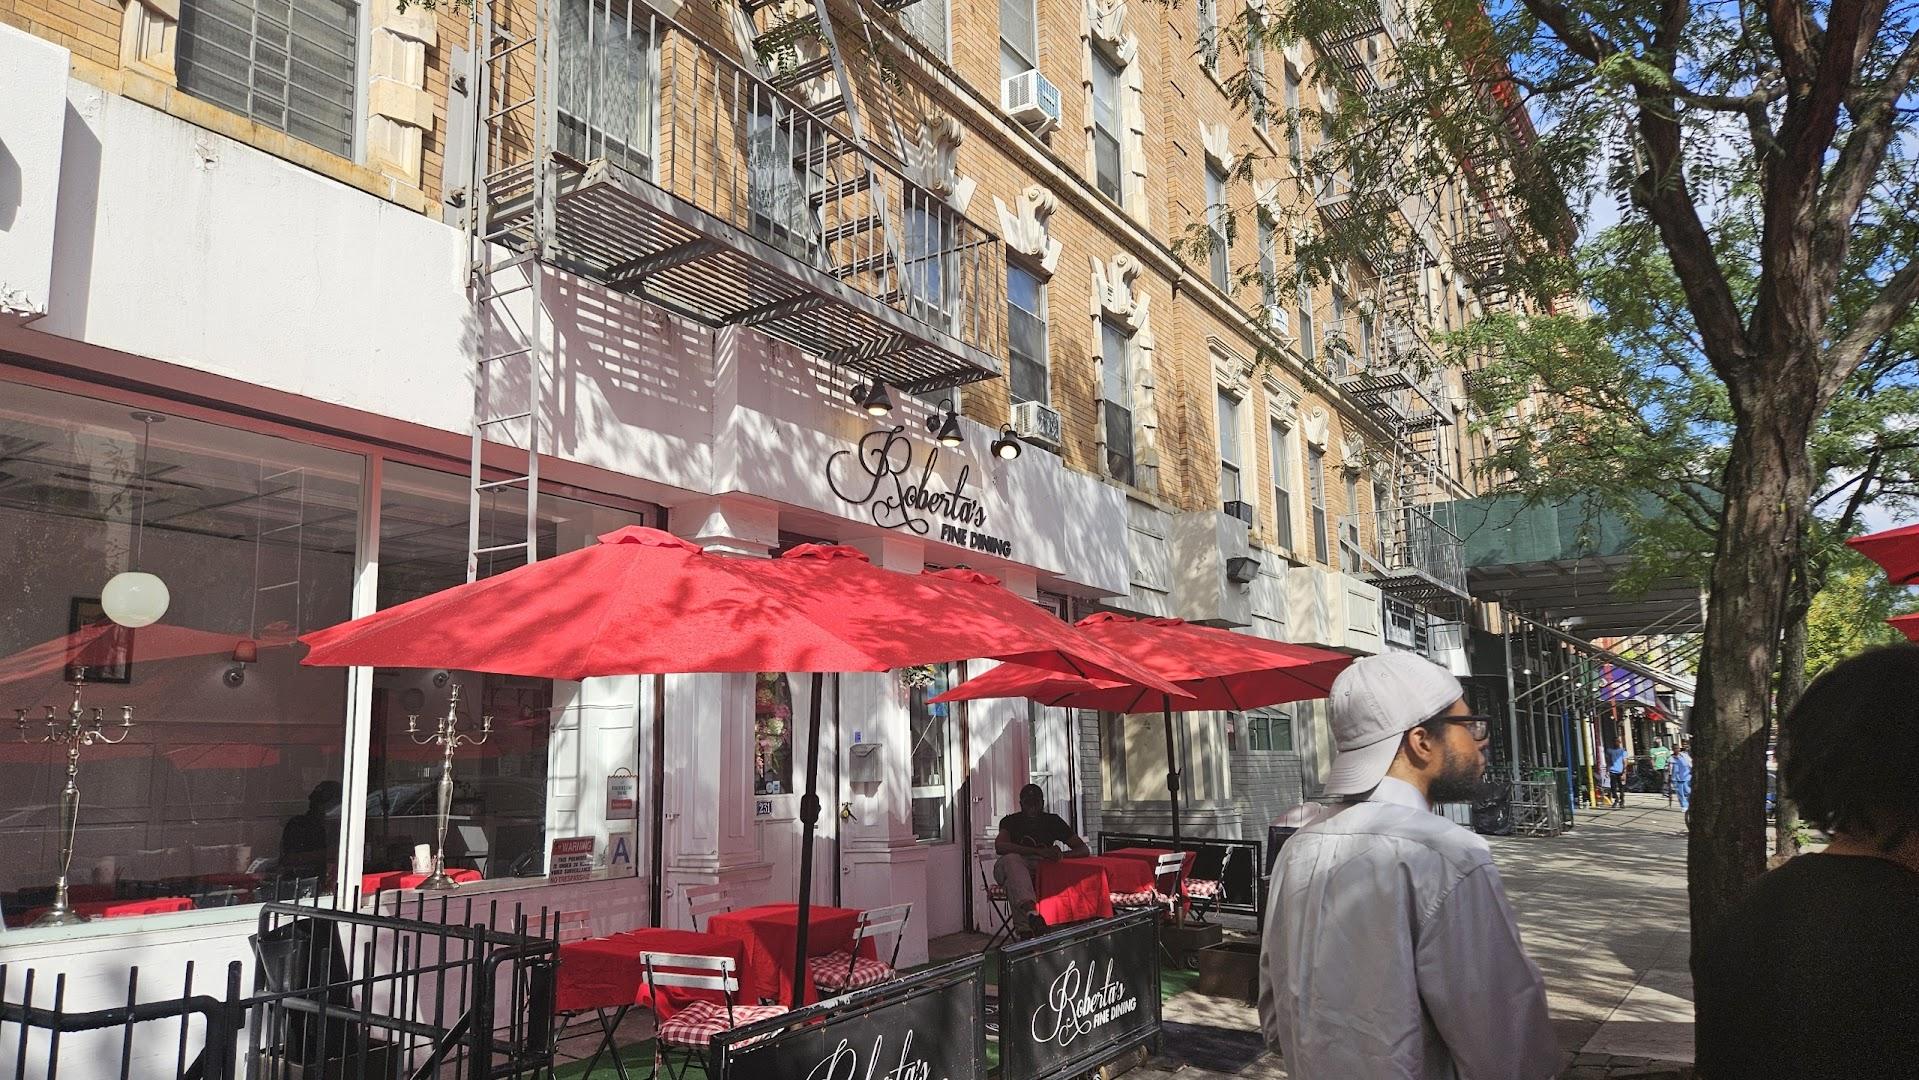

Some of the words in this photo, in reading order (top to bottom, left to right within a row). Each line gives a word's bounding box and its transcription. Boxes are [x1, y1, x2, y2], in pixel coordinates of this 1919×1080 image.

[826, 425, 987, 534] Roberta's
[940, 523, 967, 546] FINE
[969, 530, 1012, 558] DINING
[562, 840, 592, 852] WARNING
[611, 837, 630, 864] A
[1031, 957, 1126, 1047] Roberta's
[1093, 1008, 1110, 1028] FINE
[1110, 997, 1137, 1020] DINING
